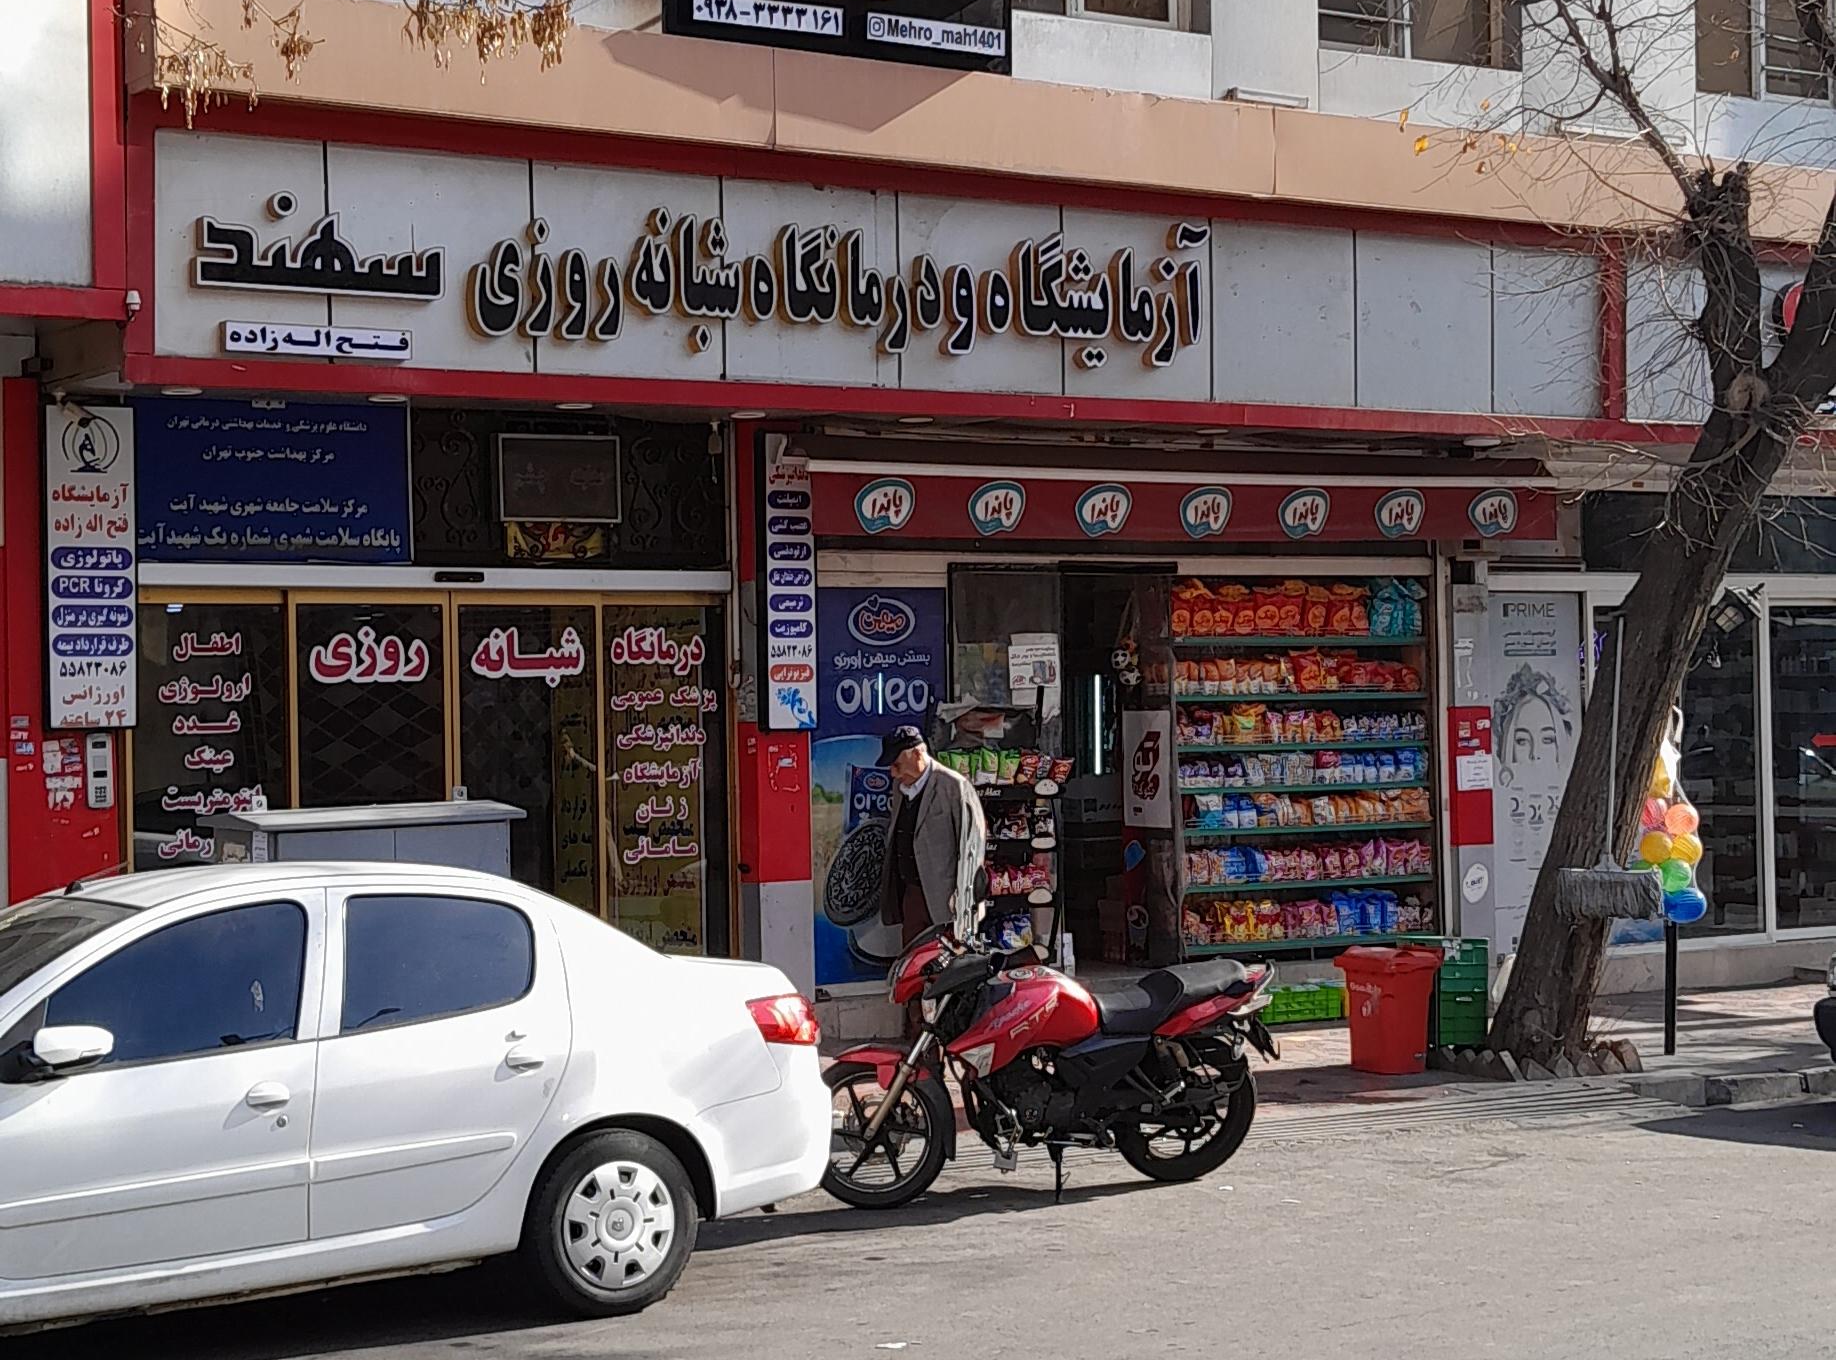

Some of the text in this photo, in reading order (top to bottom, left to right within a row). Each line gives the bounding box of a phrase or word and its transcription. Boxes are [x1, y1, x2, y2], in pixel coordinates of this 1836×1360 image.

[886, 18, 1003, 52] Mehro_mah1401
[189, 189, 446, 301] سهند
[467, 216, 626, 341] روزی
[628, 206, 744, 354] شبانه
[742, 222, 945, 354] درمانگاه
[979, 222, 1210, 368] آزمایشگاه
[229, 325, 280, 352] زاده
[335, 331, 410, 355] فتح
[202, 445, 335, 464] مرکز بهداشت جنوب تهران
[51, 482, 130, 510] آزمایشگاه
[168, 493, 197, 515] آیت
[198, 495, 229, 516] شهید
[229, 496, 264, 517] شهری
[301, 496, 340, 514] سلامت
[340, 498, 369, 518] مرکز
[870, 488, 904, 518] پاندا
[983, 489, 1015, 521] پاندا
[1090, 493, 1121, 523] پاندا
[1193, 495, 1221, 525] پاندا
[1292, 496, 1320, 525] پاندا
[1387, 497, 1415, 525] پاندا
[1481, 499, 1508, 522] پاندا
[54, 512, 83, 539] زاده
[106, 512, 129, 539] فتح
[165, 525, 202, 550] شهید
[203, 525, 230, 547] یک
[229, 524, 272, 552] شماره
[273, 526, 312, 552] شهری
[314, 526, 361, 548] سلامت
[361, 526, 401, 554] پایگاه
[59, 548, 124, 569] پاتولوژی
[59, 577, 91, 594] PCR
[858, 608, 907, 635] میهن
[1502, 602, 1556, 618] PRIME
[173, 631, 242, 662] اطفال
[310, 625, 706, 687] درمانگاه شبانه روزی
[862, 651, 898, 669] میهن
[897, 649, 931, 667] بستنی
[62, 683, 126, 706] اورژانس
[610, 685, 718, 712] پزشک عمومی
[104, 708, 127, 726] ۲۴
[171, 710, 242, 735] غدد
[616, 723, 707, 752] دندانپزشکی
[184, 745, 235, 774] عینک
[623, 757, 701, 789] آزمایشگاه
